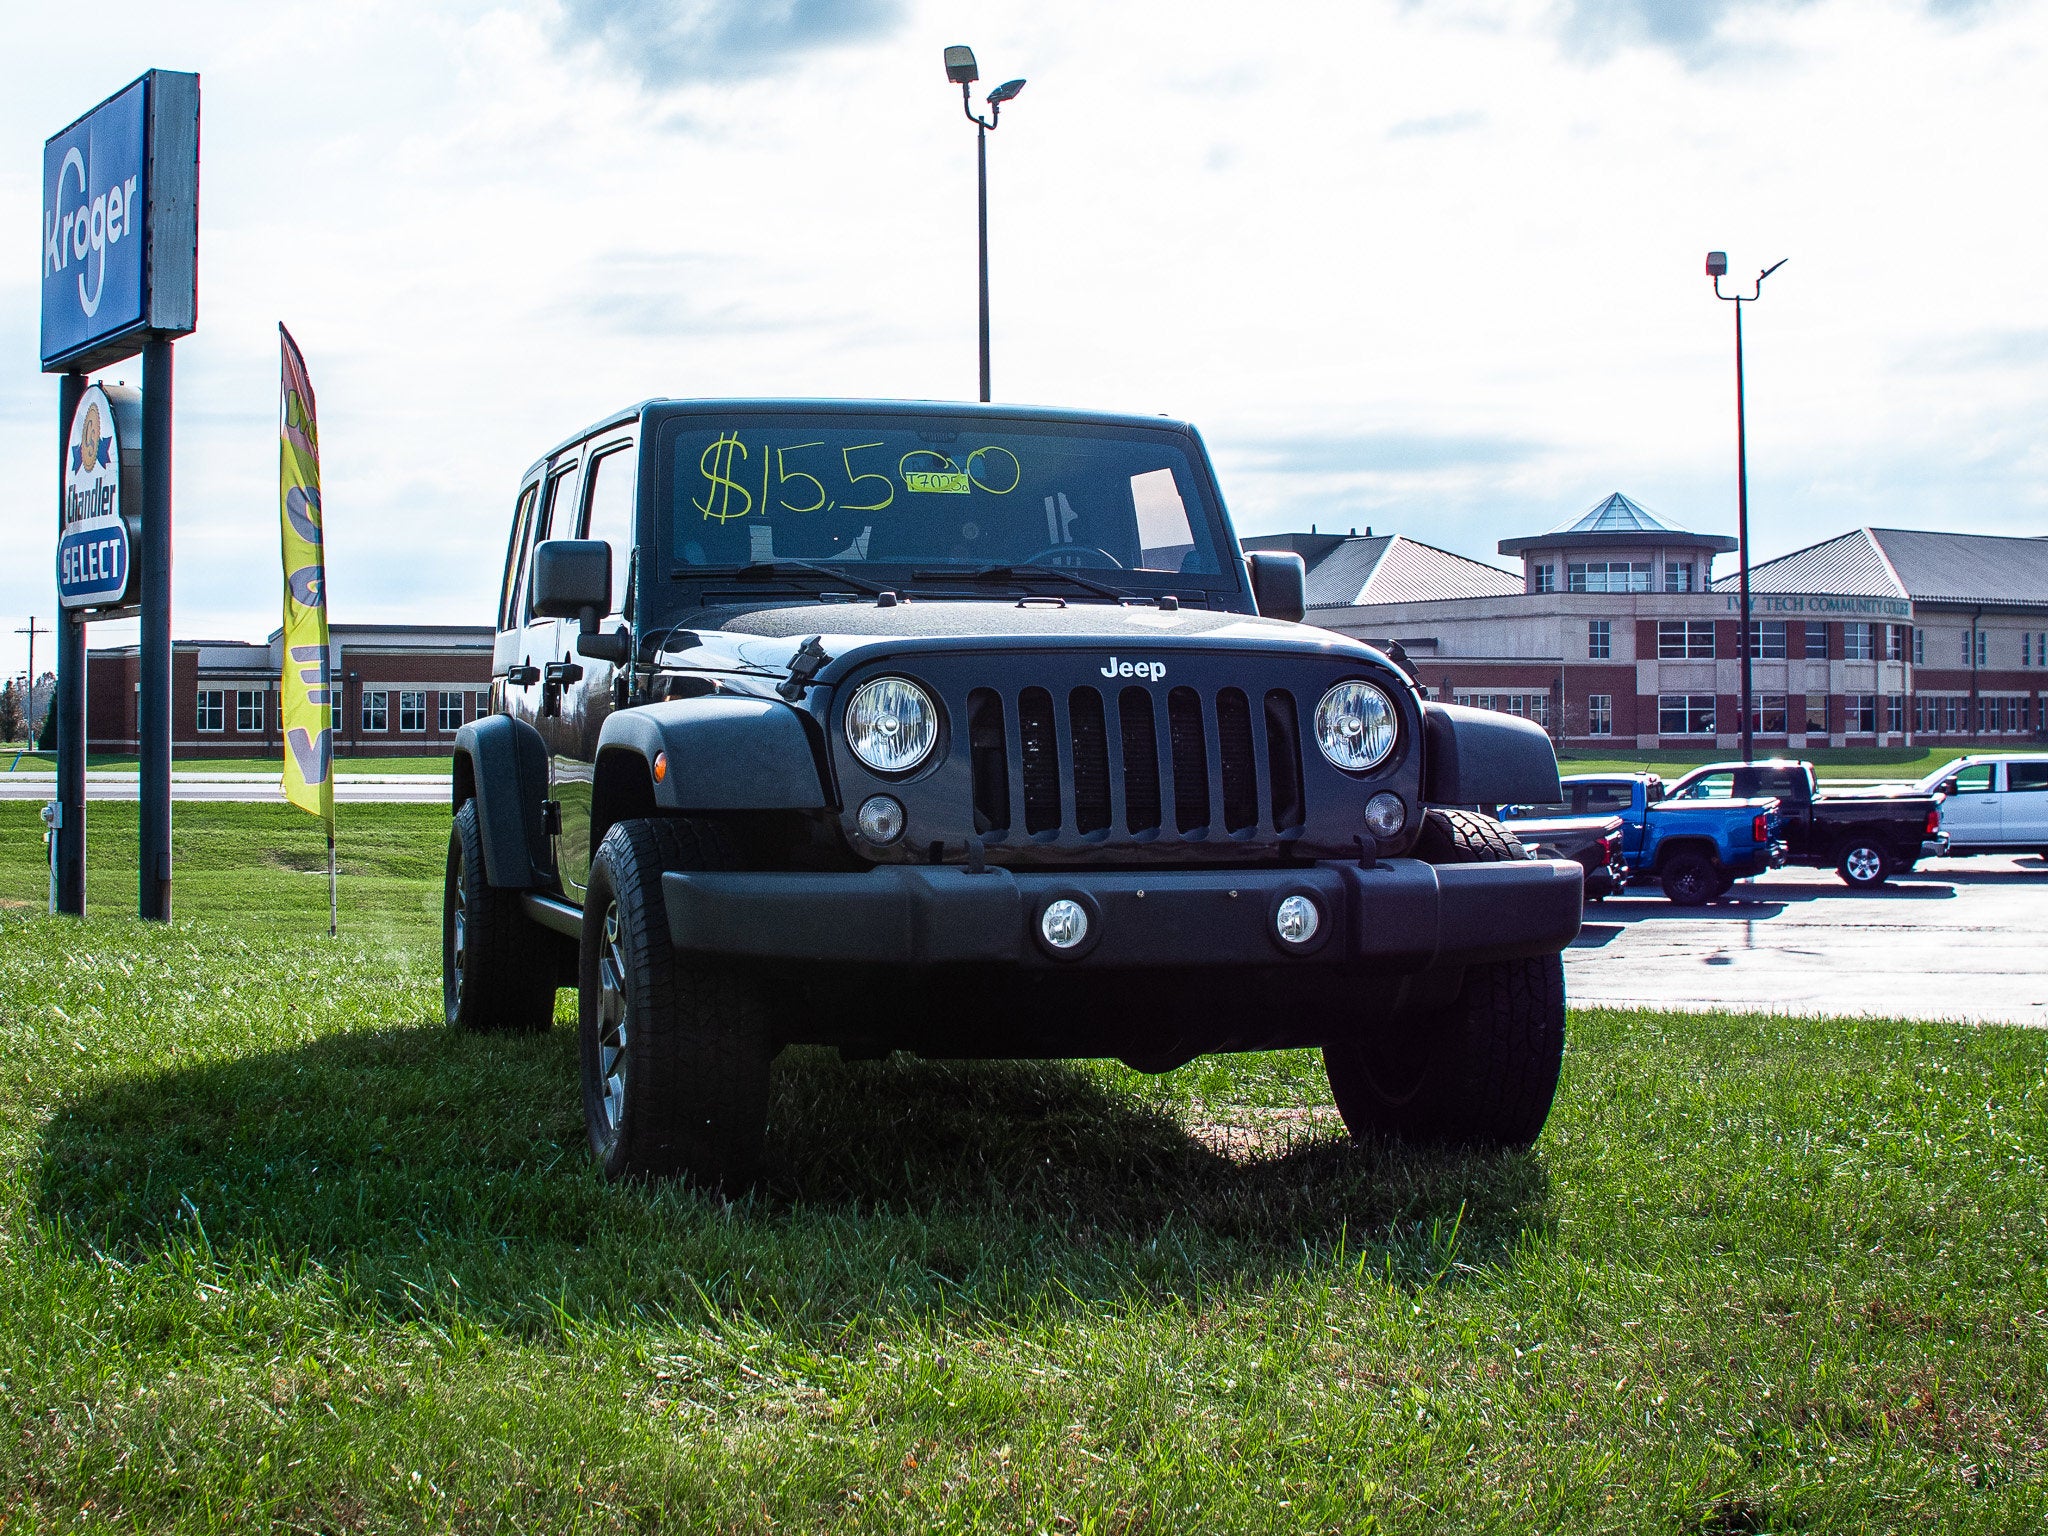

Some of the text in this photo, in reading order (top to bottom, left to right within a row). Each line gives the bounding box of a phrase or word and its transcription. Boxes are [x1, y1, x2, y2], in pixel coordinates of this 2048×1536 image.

[44, 147, 137, 317] Kroger
[67, 477, 116, 523] Chandler
[62, 538, 121, 585] SELECT
[1762, 597, 1804, 612] TECH
[1808, 597, 1883, 614] COMMUNITY
[1100, 656, 1167, 682] Jeep
